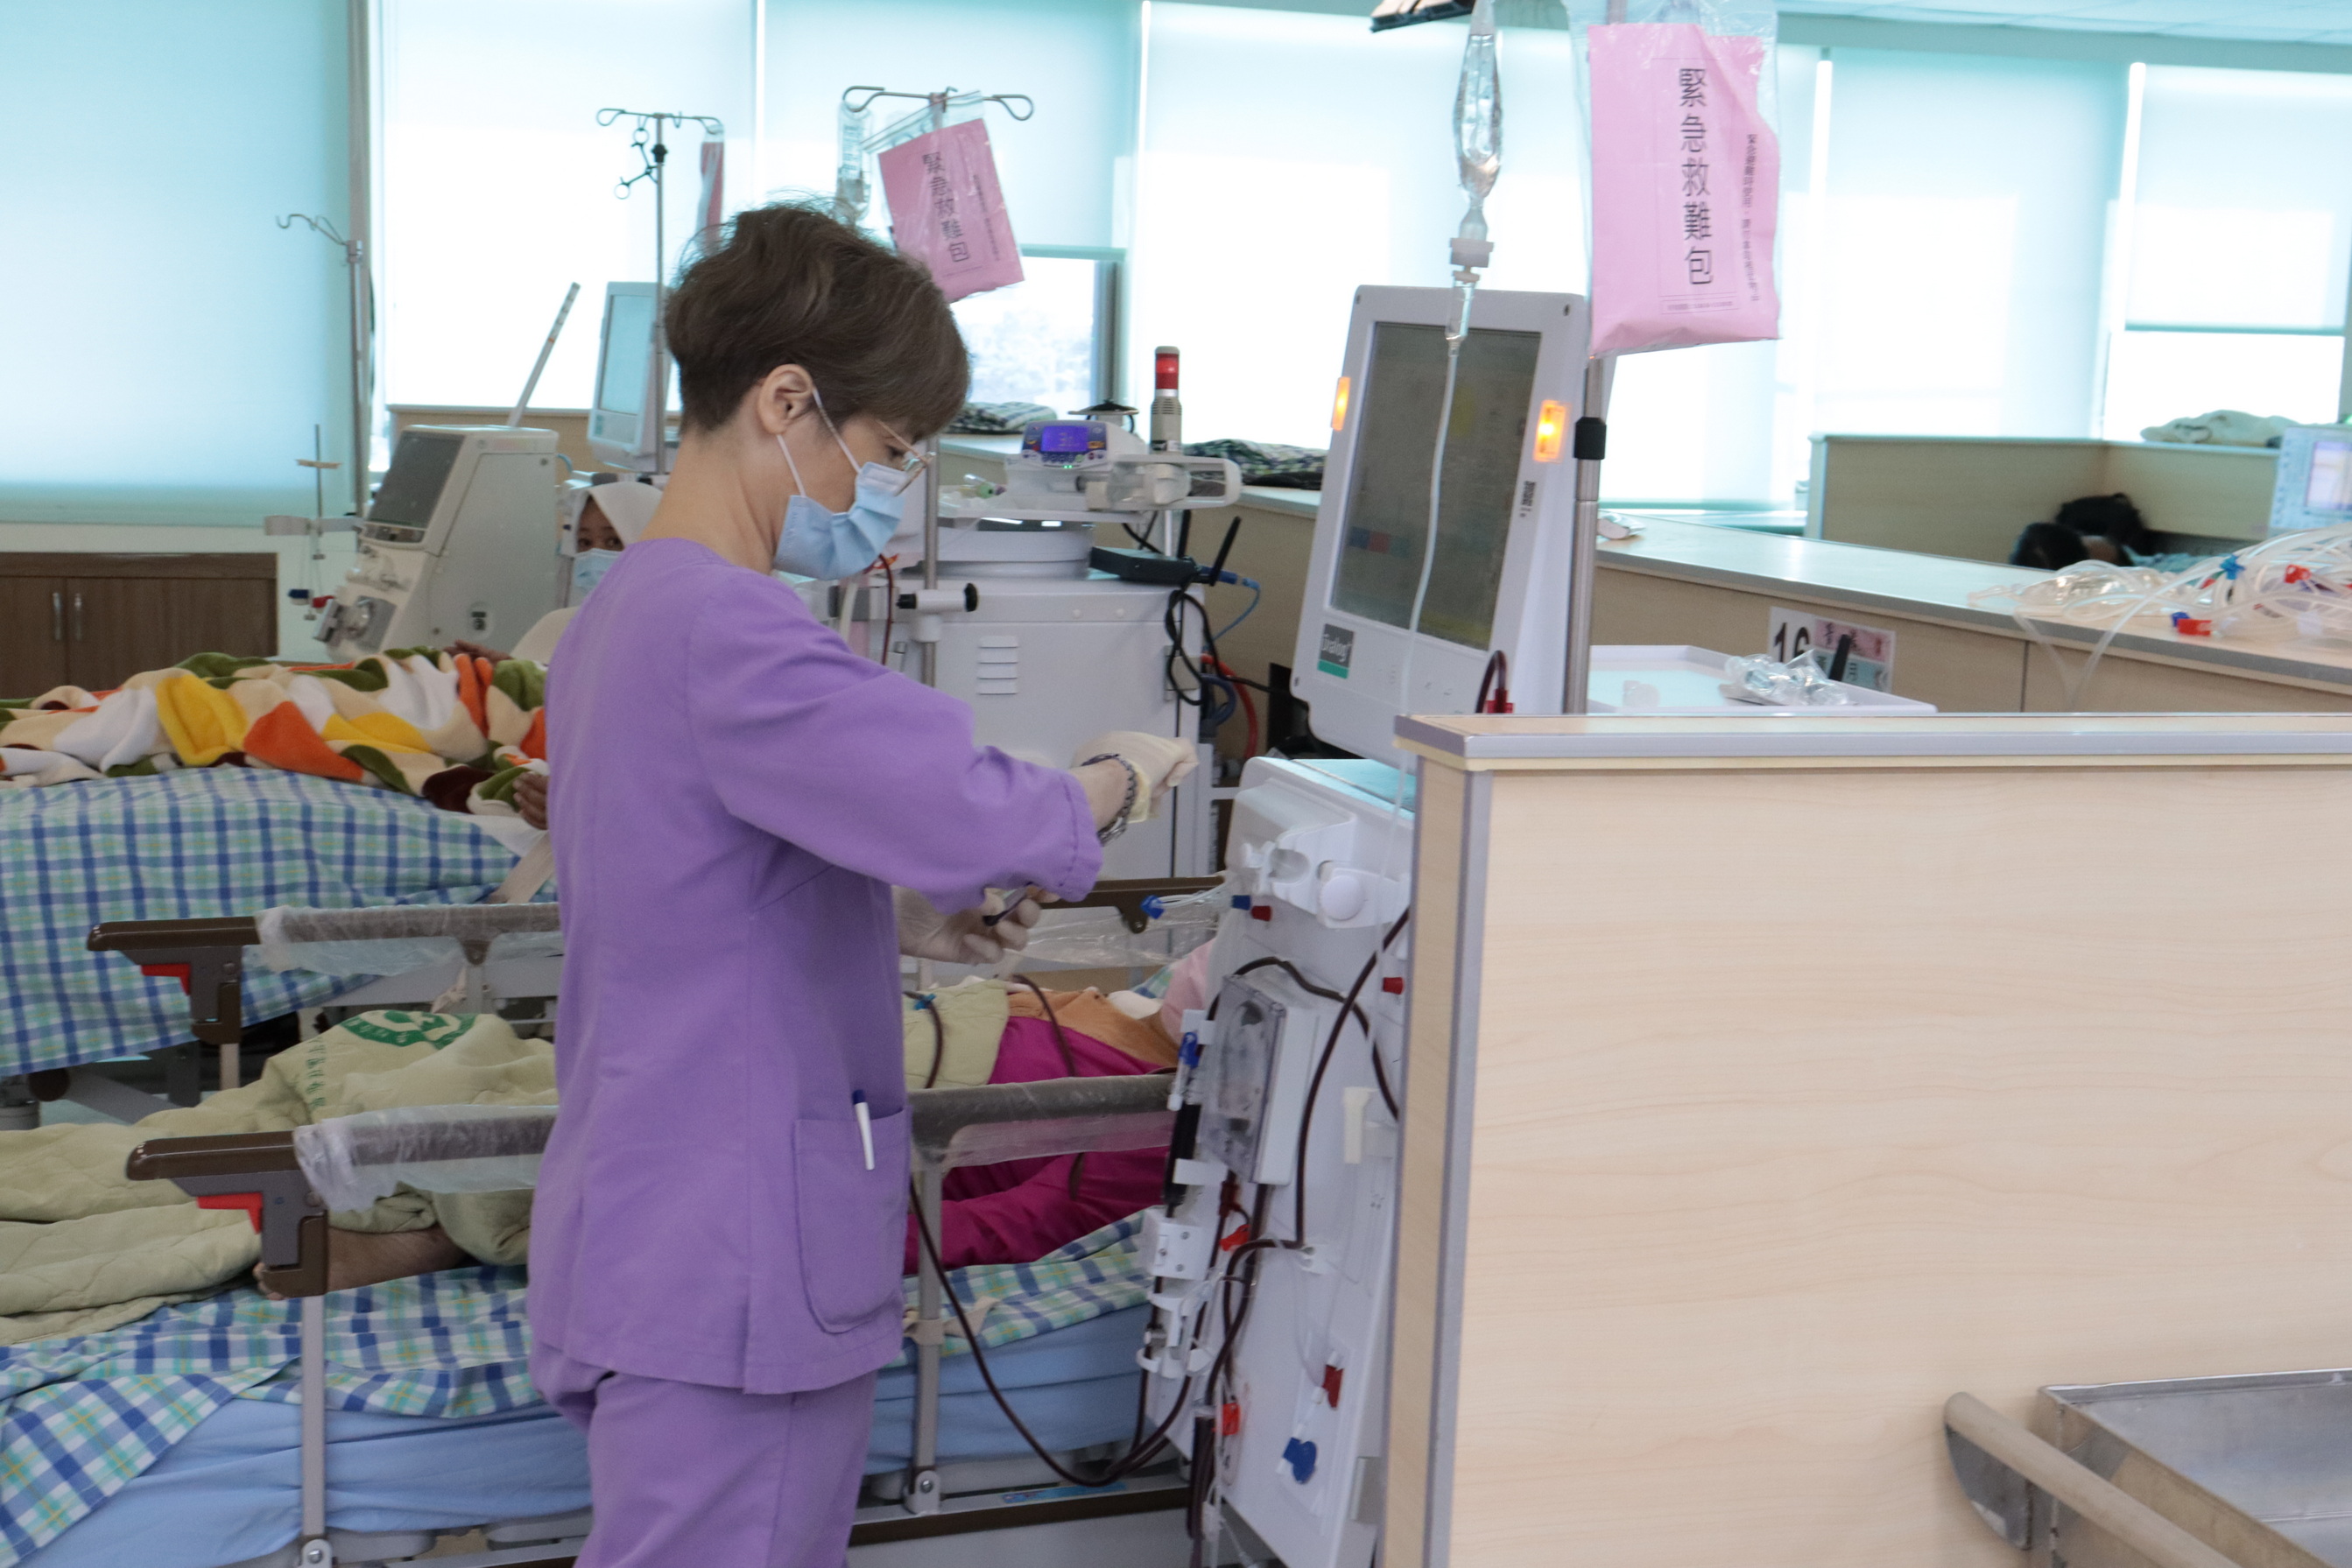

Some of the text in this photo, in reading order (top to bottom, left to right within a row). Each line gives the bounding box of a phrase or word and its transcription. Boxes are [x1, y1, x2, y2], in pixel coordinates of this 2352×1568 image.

[1679, 67, 1714, 286] 緊急救難包
